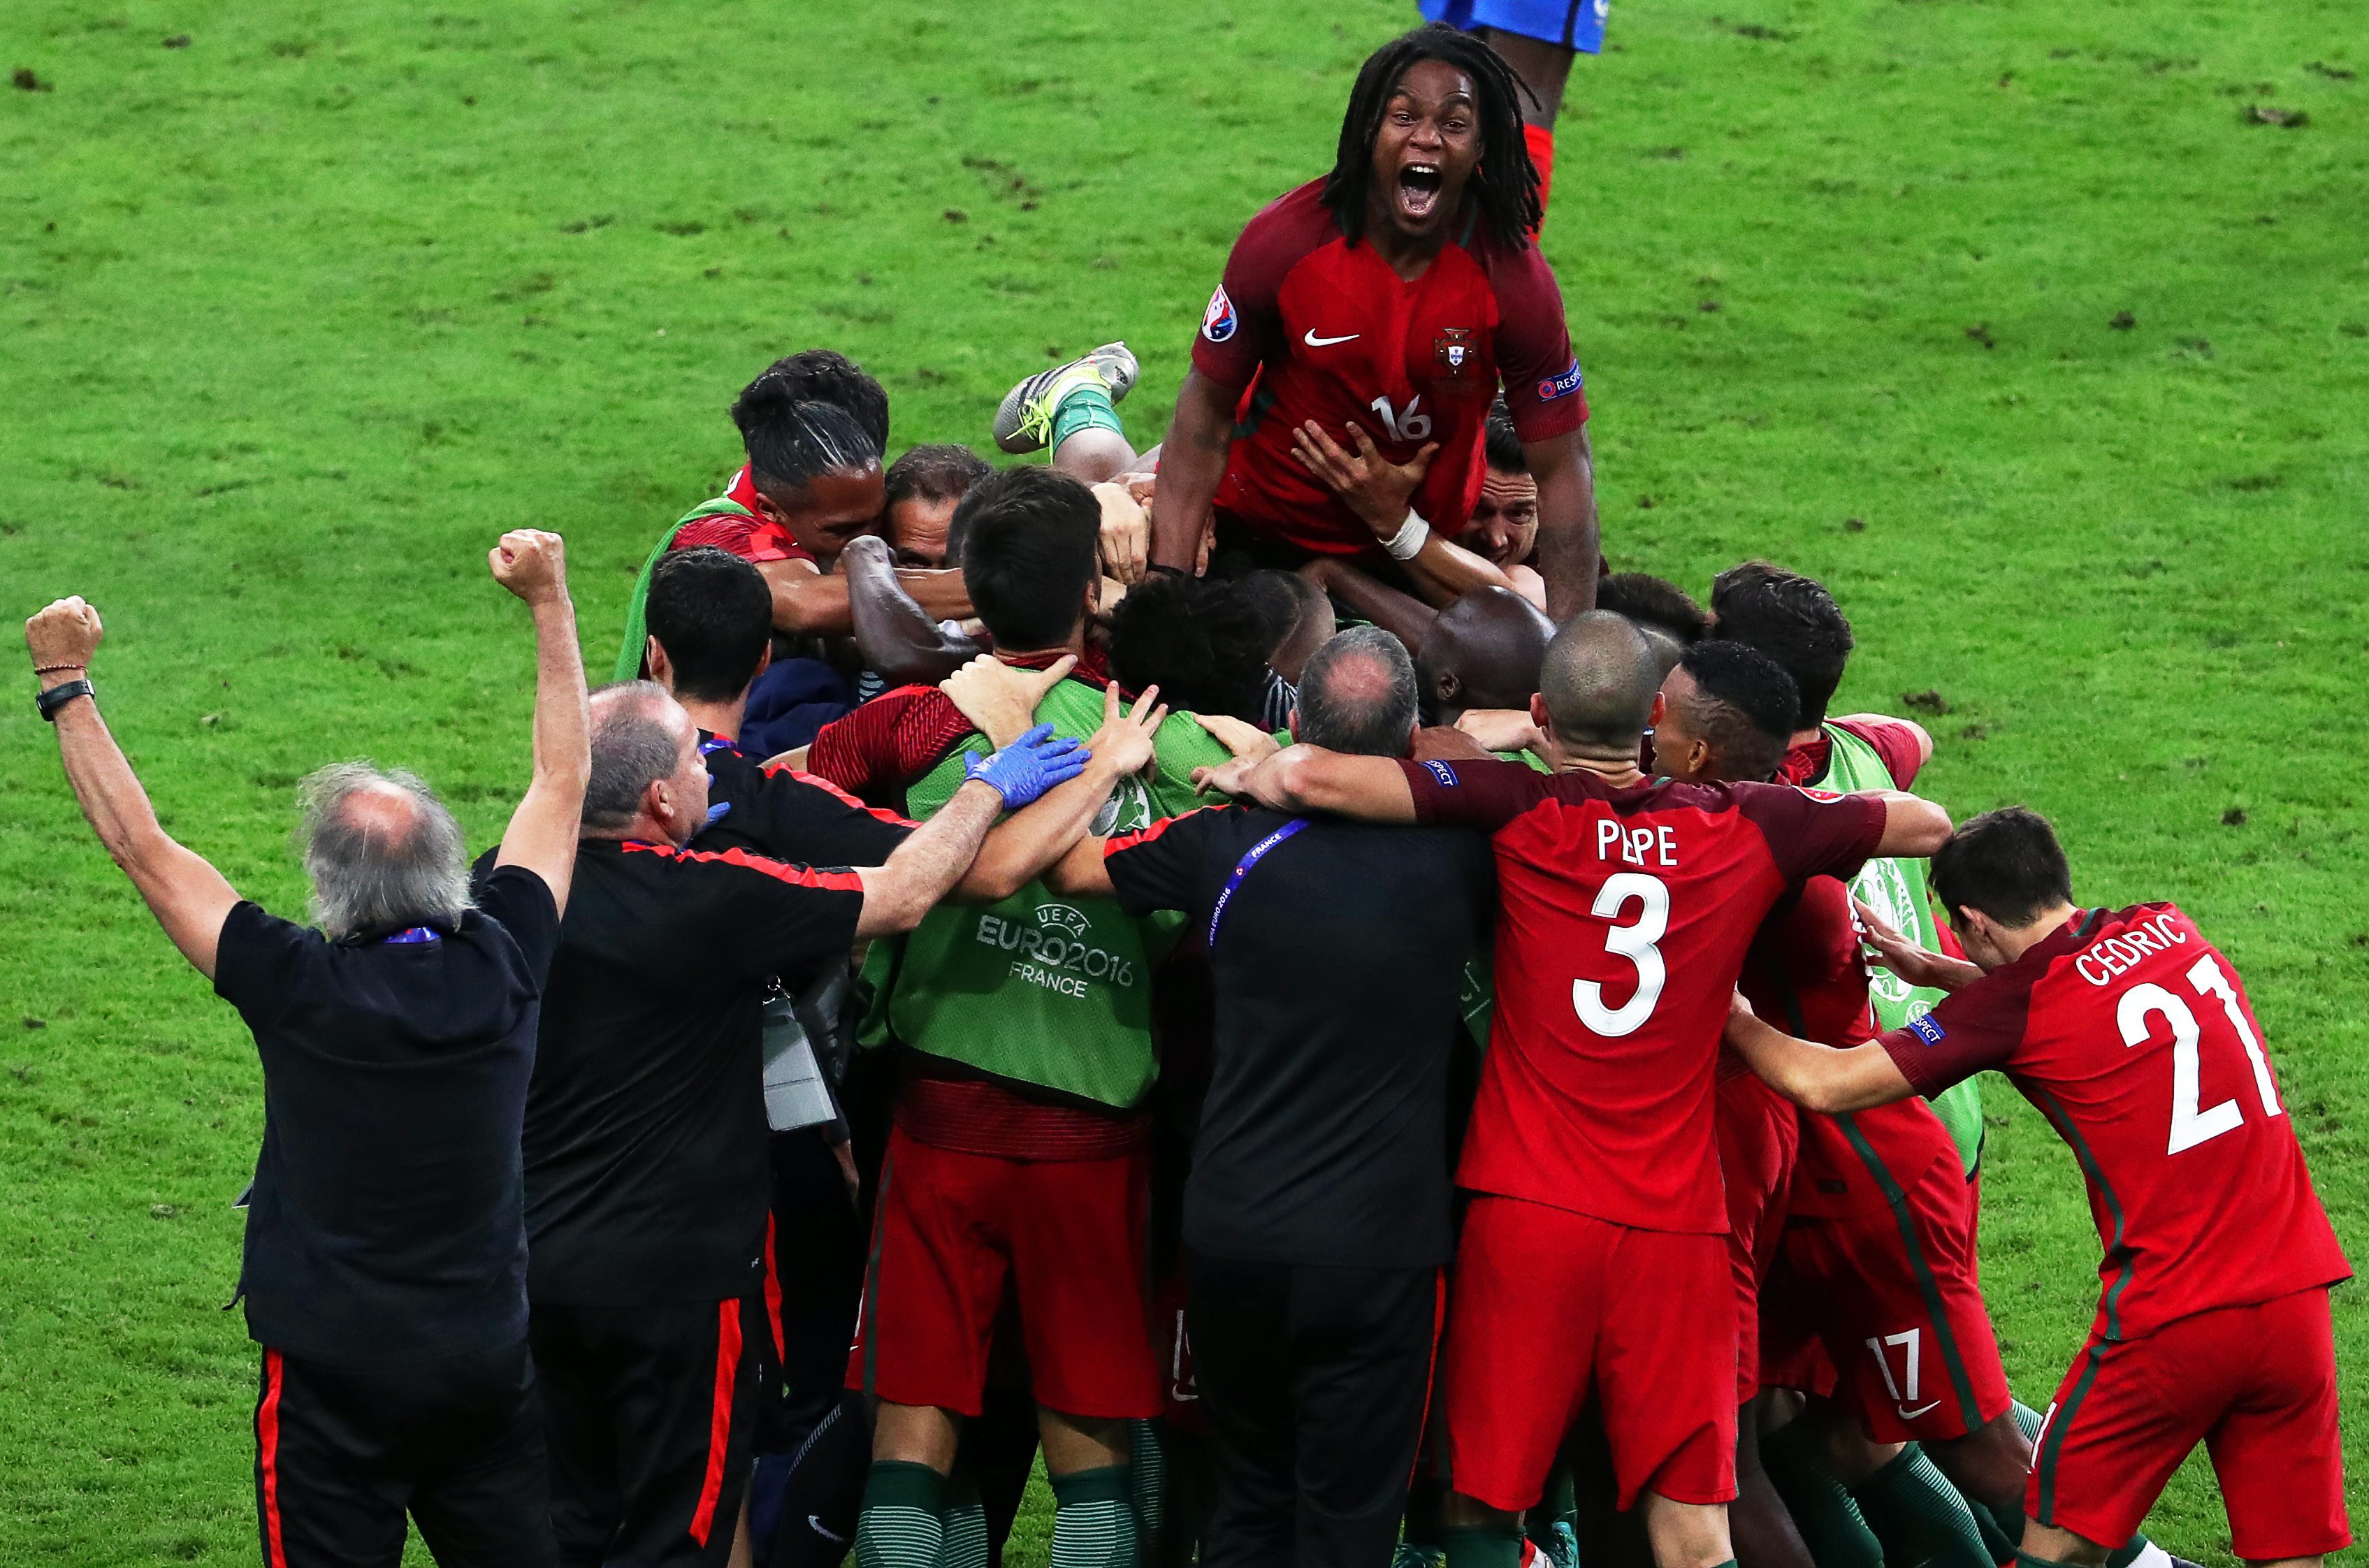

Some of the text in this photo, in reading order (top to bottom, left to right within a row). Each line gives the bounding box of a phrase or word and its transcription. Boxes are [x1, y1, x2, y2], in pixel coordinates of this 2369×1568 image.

[1371, 394, 1432, 442] 16
[1252, 833, 1282, 858] FRANCE
[1598, 819, 1678, 866] PEPE
[1037, 908, 1086, 936] UEFA
[1211, 906, 1221, 928] EURO
[1217, 887, 1231, 908] 2016
[1572, 872, 1670, 1038] 3
[2075, 913, 2187, 986] CEDRIC
[1008, 961, 1088, 998] FRANCE
[2116, 953, 2283, 1156] 21
[1865, 1328, 1920, 1400] 17
